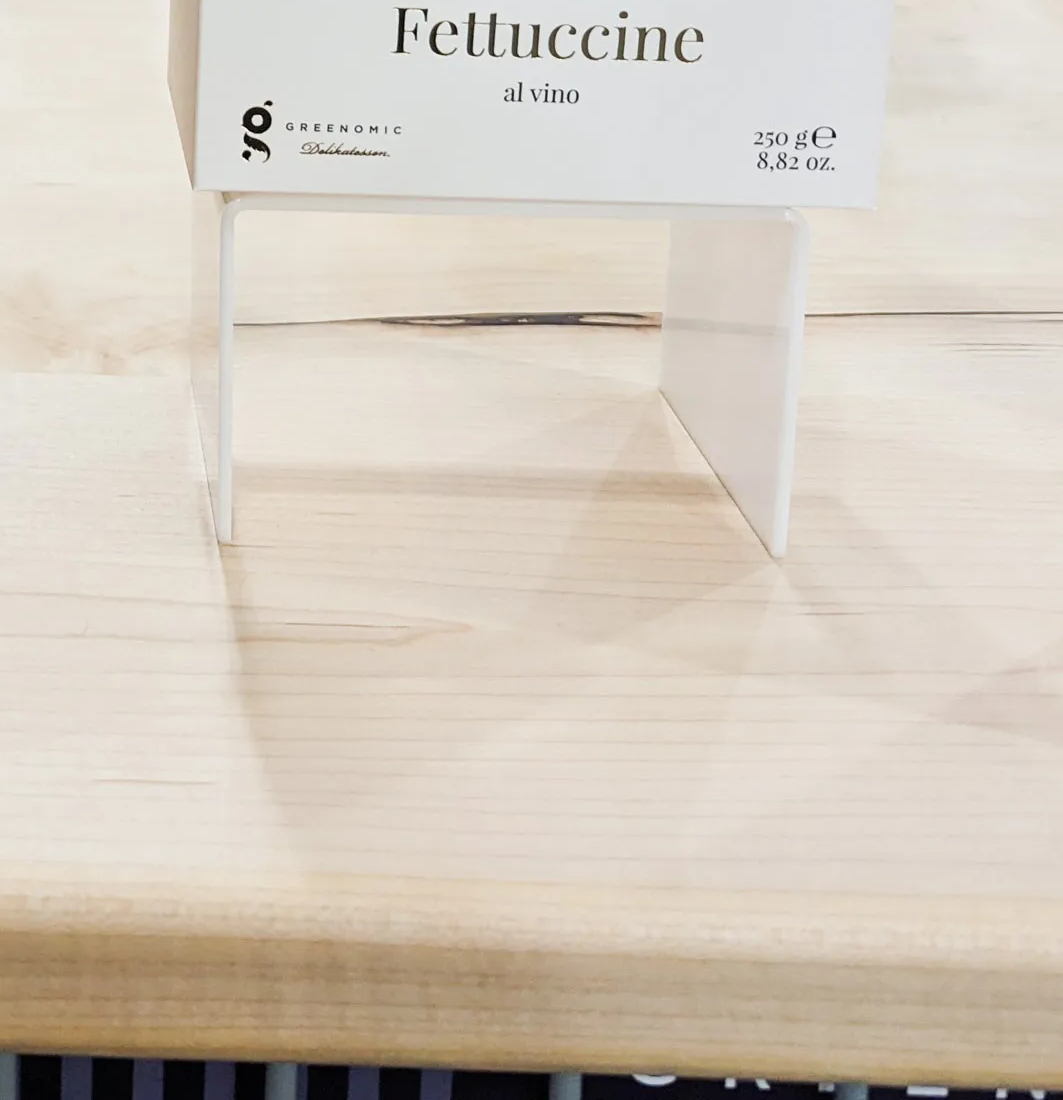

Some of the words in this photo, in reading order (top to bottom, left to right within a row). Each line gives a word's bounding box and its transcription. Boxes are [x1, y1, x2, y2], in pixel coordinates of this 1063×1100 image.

[390, 6, 705, 64] Fettuccine
[502, 81, 524, 104] al
[529, 82, 581, 105] vino
[285, 121, 403, 136] GREENOMIC
[753, 131, 789, 149] 250
[756, 150, 799, 172] 8,82
[805, 155, 836, 172] oz.
